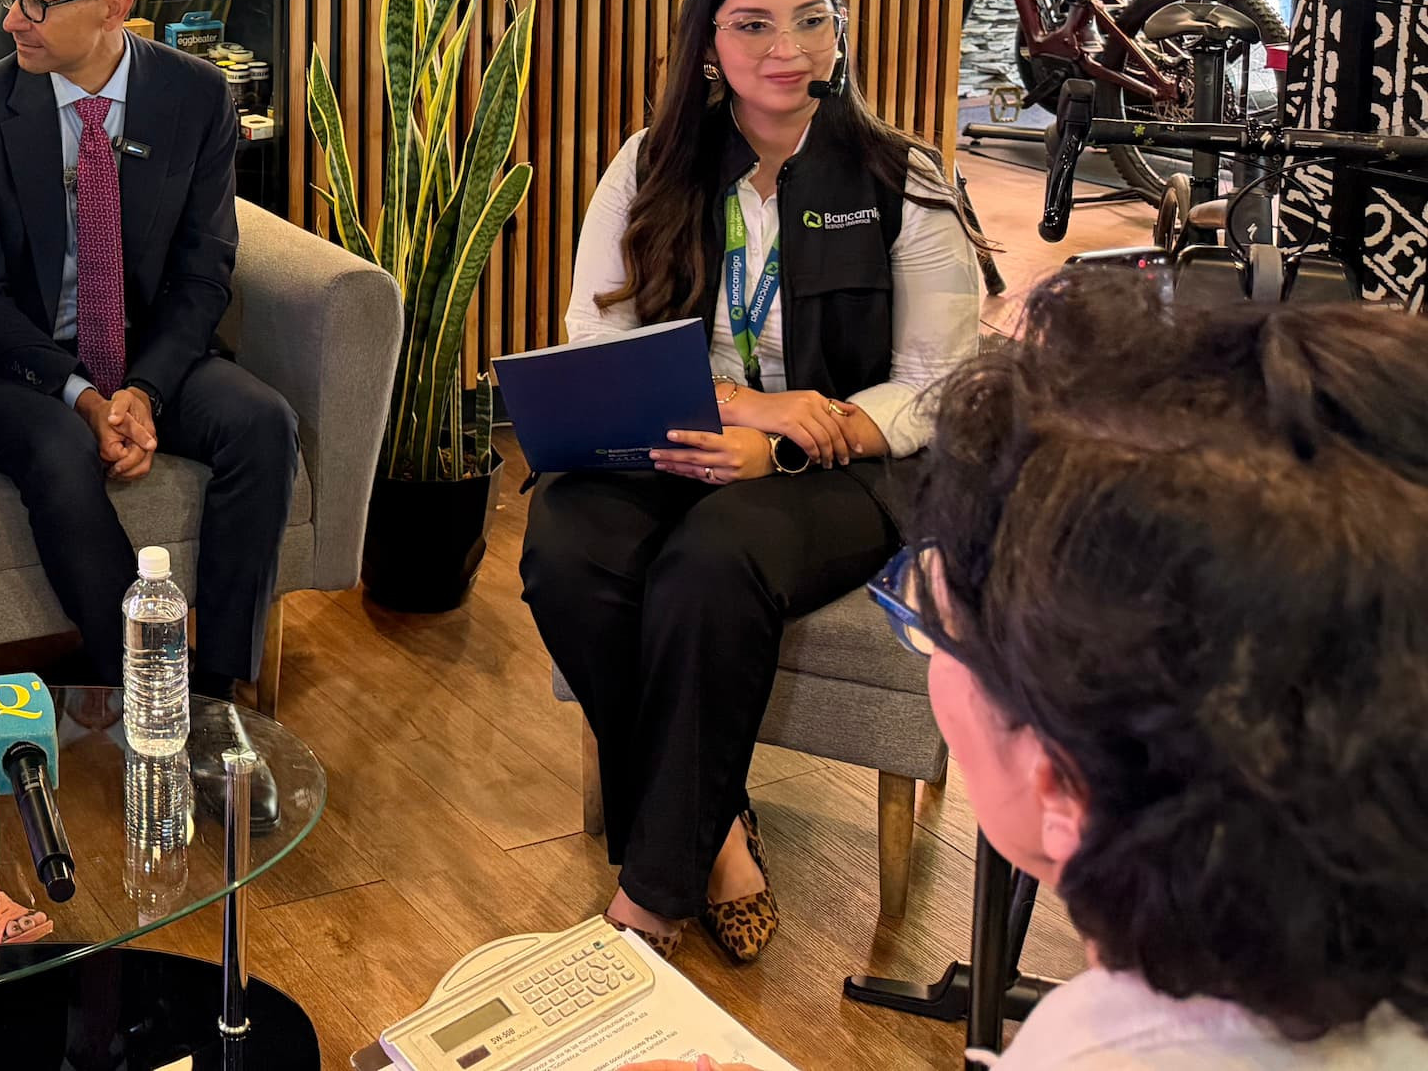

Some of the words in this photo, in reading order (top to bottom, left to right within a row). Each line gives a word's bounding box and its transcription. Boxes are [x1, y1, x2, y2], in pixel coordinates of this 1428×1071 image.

[177, 34, 218, 47] eggbeater
[731, 255, 742, 306] Bancamiga
[750, 274, 775, 323] Bancamiga
